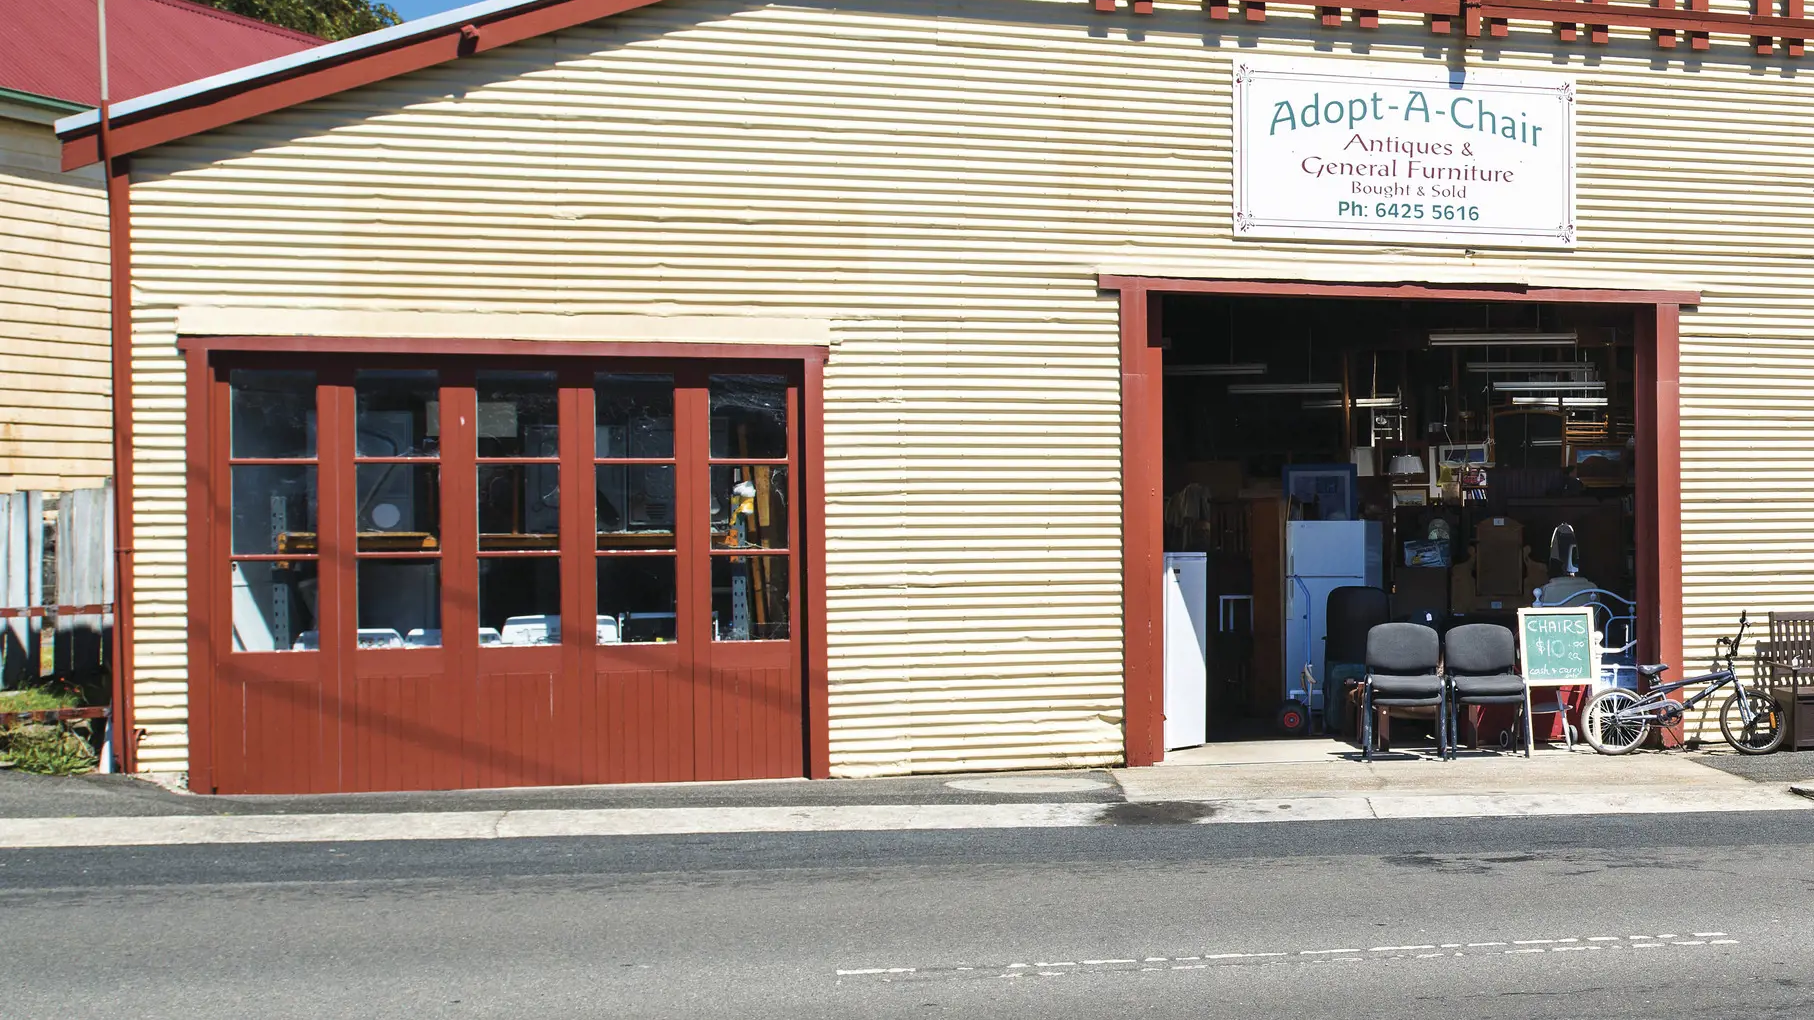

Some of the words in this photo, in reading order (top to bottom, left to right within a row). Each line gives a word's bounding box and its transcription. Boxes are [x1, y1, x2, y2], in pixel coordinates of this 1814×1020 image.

[1269, 90, 1543, 147] Adopt-A-Chair
[1343, 133, 1453, 159] Antiques
[1461, 141, 1474, 157] &
[1301, 156, 1397, 178] General
[1407, 160, 1514, 183] Furniture
[1351, 181, 1410, 198] Bought
[1416, 186, 1426, 197] &
[1431, 184, 1467, 199] Sold
[1338, 200, 1368, 217] Ph:
[1375, 202, 1425, 220] 6425
[1432, 204, 1480, 222] 5616
[1527, 620, 1586, 634] CHAIRS
[1529, 664, 1550, 675] cash
[1559, 666, 1583, 676] carry
